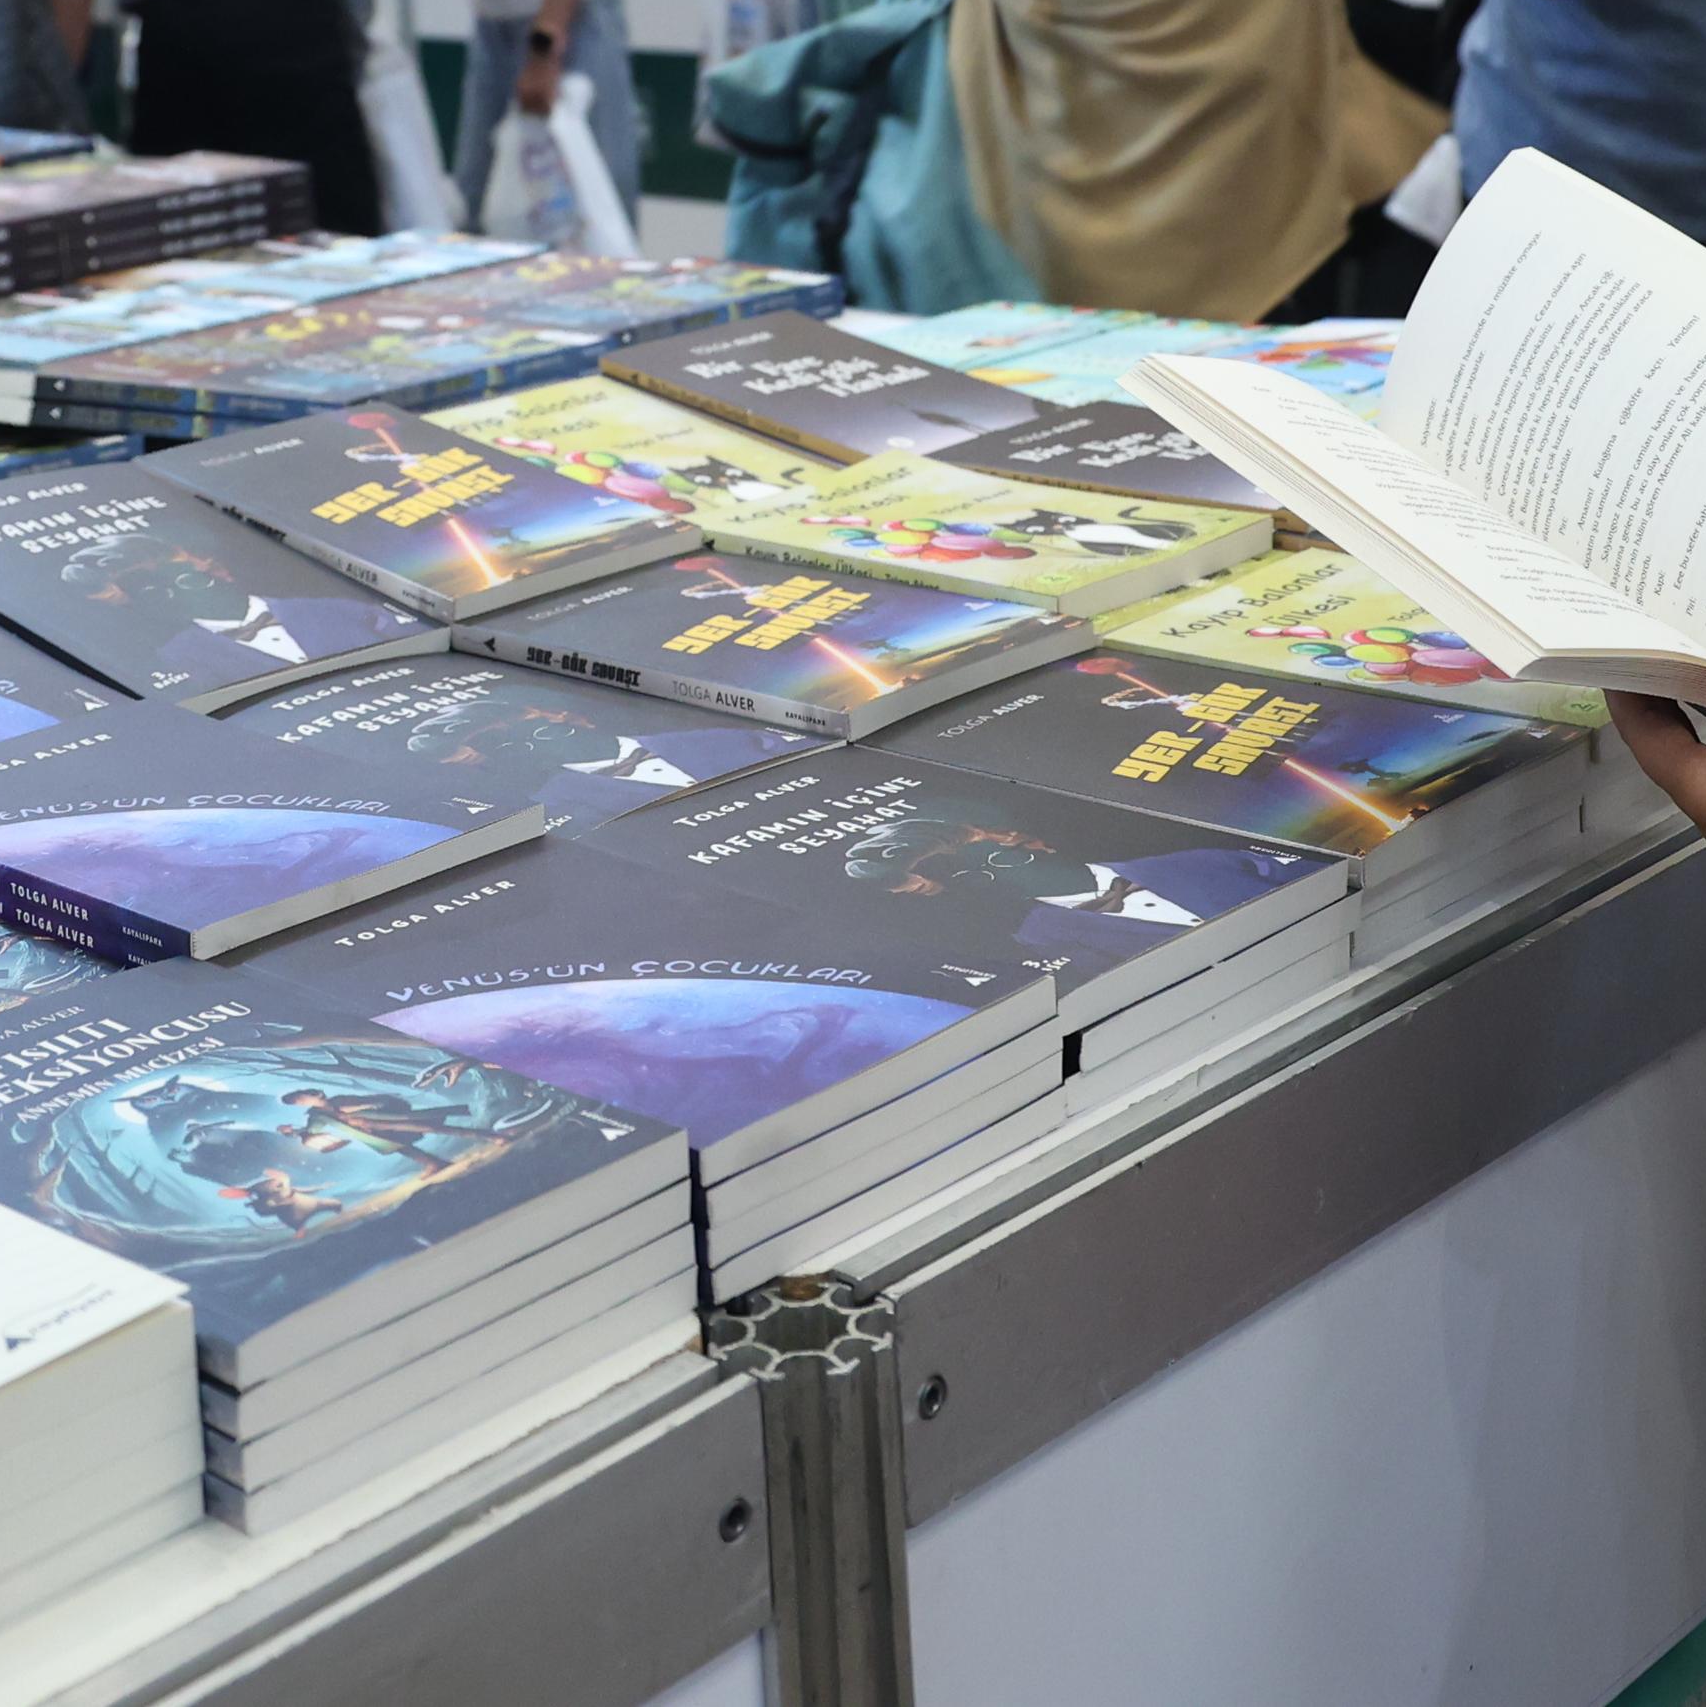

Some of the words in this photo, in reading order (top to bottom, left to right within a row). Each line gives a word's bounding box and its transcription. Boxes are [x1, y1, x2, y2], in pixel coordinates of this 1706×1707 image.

[1657, 442, 1685, 486] Mehmet
[78, 494, 169, 520] İÇİNE
[19, 514, 153, 555] SEYAHAT
[1159, 607, 1249, 640] Kayıp
[1236, 562, 1345, 610] Balonlar
[1262, 593, 1357, 628] Ülkesi
[271, 685, 346, 712] TOLGA
[351, 667, 417, 688] ALVER
[276, 692, 411, 745] KAFAMIN
[410, 669, 505, 694] İÇİNE
[355, 685, 492, 733] SEYAHAT
[714, 692, 757, 714] ALVER
[936, 712, 992, 740] TOLGA
[991, 694, 1046, 718] ALVER
[32, 732, 113, 761] ALVER
[186, 792, 391, 814] ÇOCUKLARI
[672, 800, 750, 829] TOLGA
[754, 774, 821, 802] ALVER
[687, 805, 830, 866] KAFAMIN
[822, 775, 923, 811] İÇİNE
[776, 797, 919, 856] SEYAHAT
[10, 882, 48, 907] TOLGA
[52, 898, 89, 922] ALVER
[333, 911, 430, 950] TOLGA
[431, 878, 517, 916] ALVER
[15, 908, 53, 933] TOLGA
[56, 923, 94, 948] ALVER
[384, 961, 607, 1004] VENÜS'ÜN
[629, 958, 873, 987] ÇOCUKLARI
[21, 1005, 86, 1033] ALVER
[16, 1078, 113, 1125] ANNEMİN
[113, 1035, 226, 1083] MUCİZESİ
